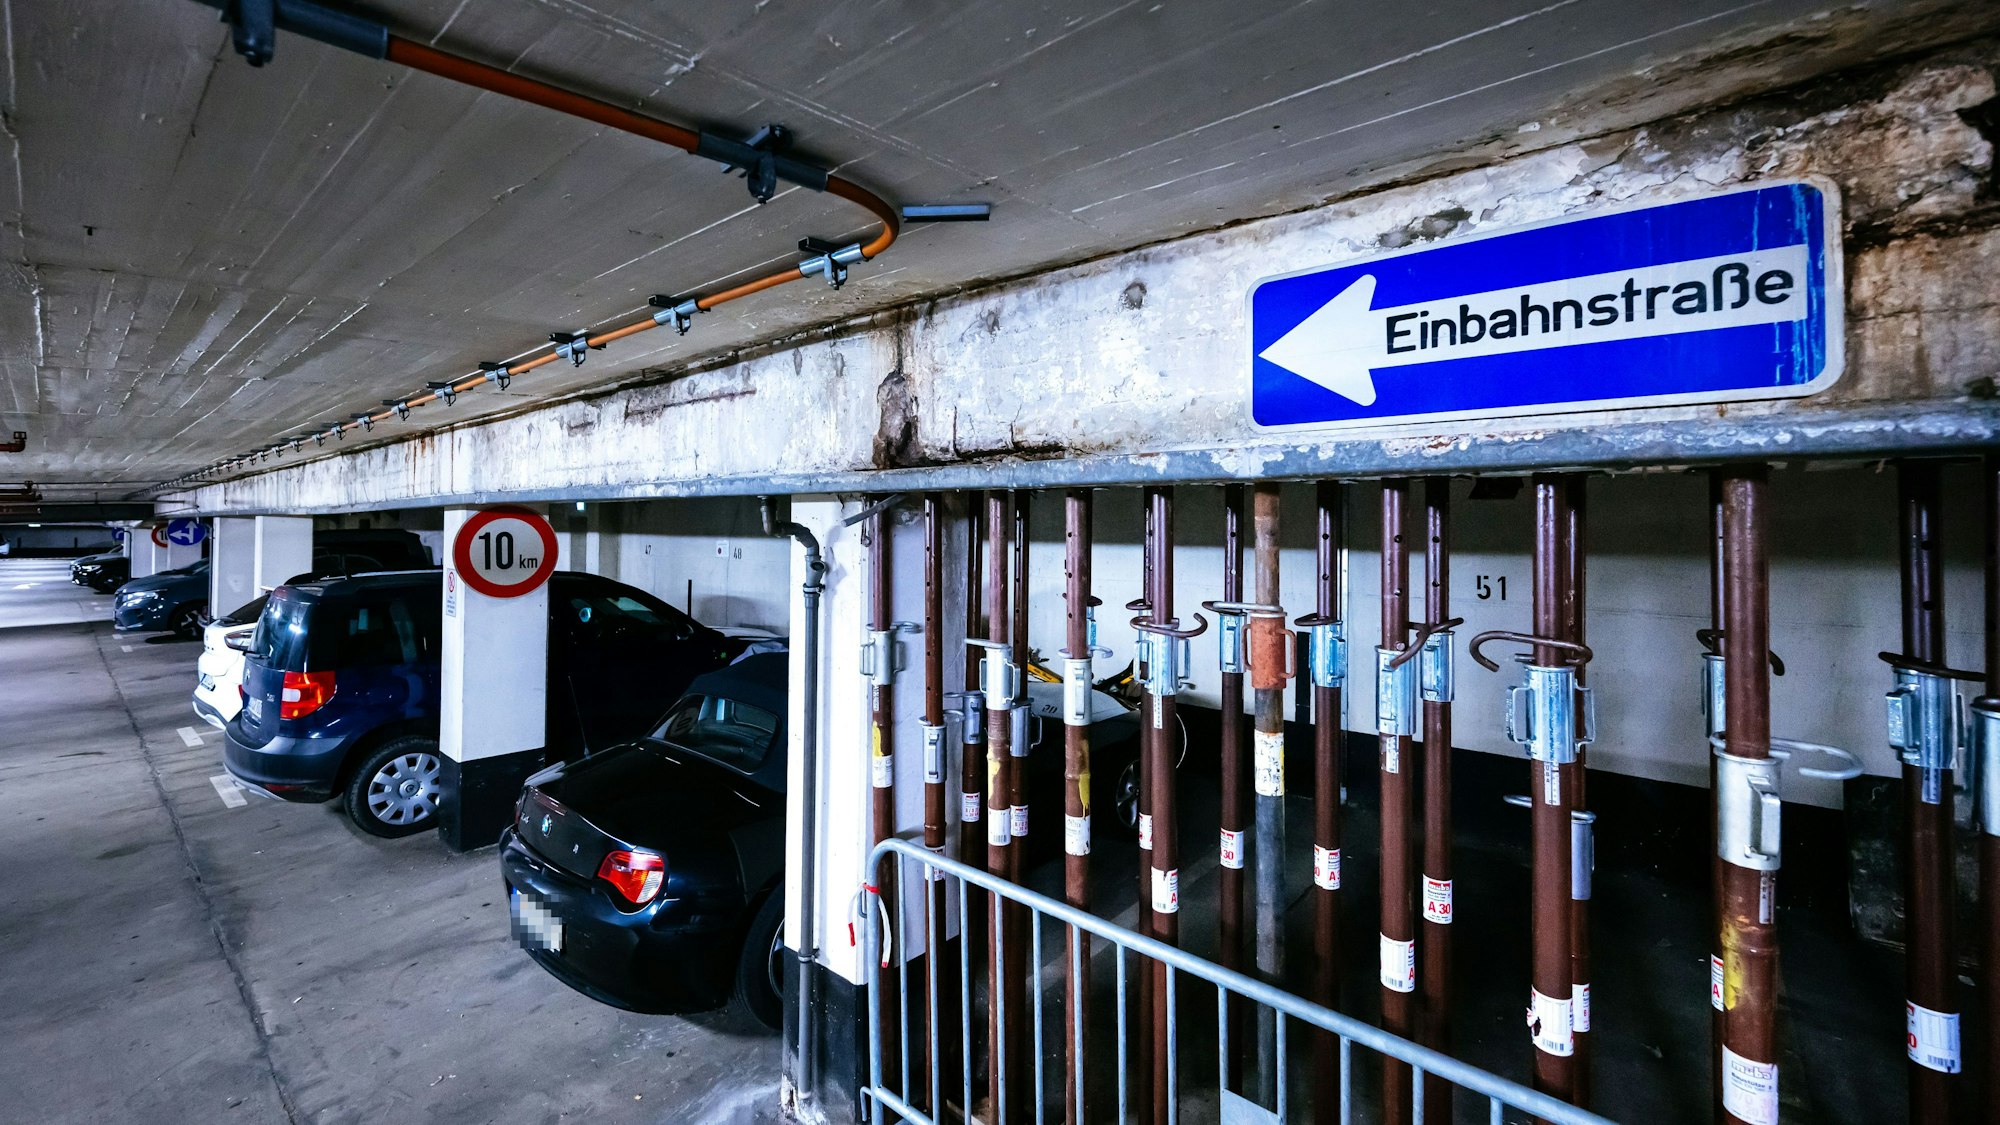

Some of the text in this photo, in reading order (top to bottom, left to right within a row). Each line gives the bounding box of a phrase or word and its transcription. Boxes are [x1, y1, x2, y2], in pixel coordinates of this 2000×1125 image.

[1386, 262, 1795, 355] Einbahnstraße
[479, 531, 538, 570] 10 km
[644, 544, 652, 555] 47
[733, 547, 743, 560] 48
[1476, 574, 1506, 601] 51
[1427, 900, 1451, 915] A 30
[1712, 982, 1721, 999] A
